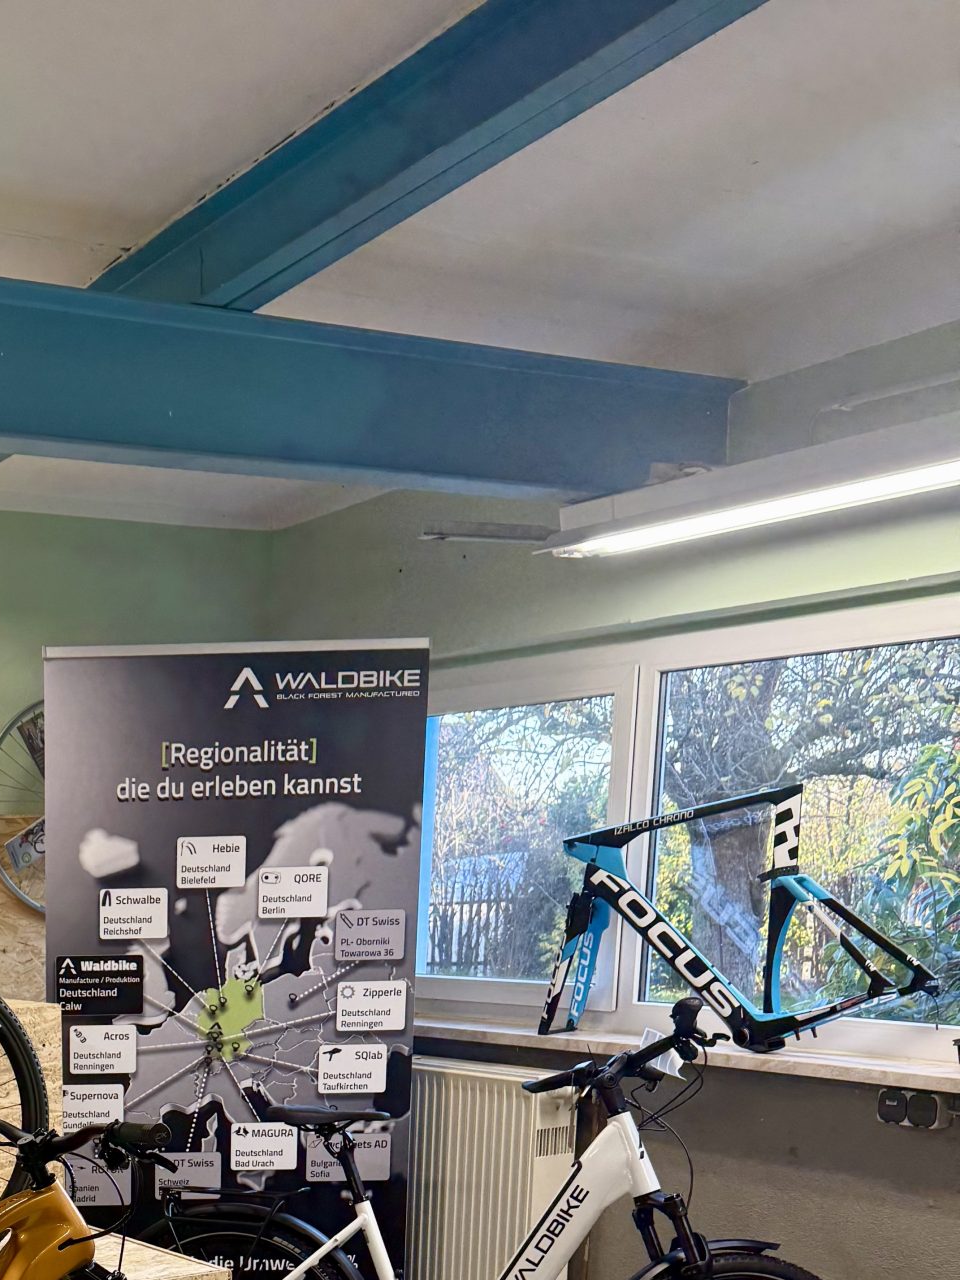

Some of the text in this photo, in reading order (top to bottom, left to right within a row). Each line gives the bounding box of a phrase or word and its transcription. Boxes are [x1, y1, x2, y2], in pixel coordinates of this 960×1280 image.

[275, 669, 421, 690] WALDBIKE
[345, 690, 420, 698] MANUFACTURED
[116, 773, 362, 800] die du erleben kannst
[614, 809, 694, 836] IZALCO CHRONO
[212, 843, 240, 853] Hebie
[180, 864, 231, 873] Deutschland
[180, 876, 216, 885] Bielefeld
[115, 895, 161, 905] Schwalbe
[262, 894, 312, 903] Deutschland
[262, 906, 286, 914] Berlin
[103, 916, 153, 924] Deutschland
[356, 916, 400, 926] DT Swiss
[103, 927, 142, 935] Reichshof
[355, 937, 390, 946] Oborniki
[589, 868, 741, 1018] FOCUS
[340, 949, 394, 957] Towarowa 36
[80, 960, 138, 972] Waldbike
[570, 931, 594, 1017] FOCUS
[59, 988, 118, 998] Deutschland
[363, 987, 402, 999] Zipperle
[59, 1001, 82, 1011] Calw
[341, 1008, 391, 1017] Deutschland
[341, 1020, 384, 1029] Renningen
[103, 1032, 130, 1041] Acros
[73, 1051, 121, 1060] Deutschland
[355, 1051, 383, 1061] SQlab
[73, 1063, 115, 1072] Renningen
[322, 1071, 372, 1080] Deutschland
[322, 1082, 369, 1091] Taufkirchen
[70, 1091, 119, 1101] Supernova
[62, 1110, 110, 1118] Deutschland
[251, 1128, 294, 1138] MAGURA
[374, 1139, 388, 1149] AD
[235, 1149, 283, 1157] Deutschland
[187, 1158, 215, 1168] Swiss
[235, 1159, 275, 1168] Bad Urach
[310, 1170, 330, 1178] Sofia
[158, 1178, 190, 1186] Schweiz
[70, 1195, 96, 1203] adrid
